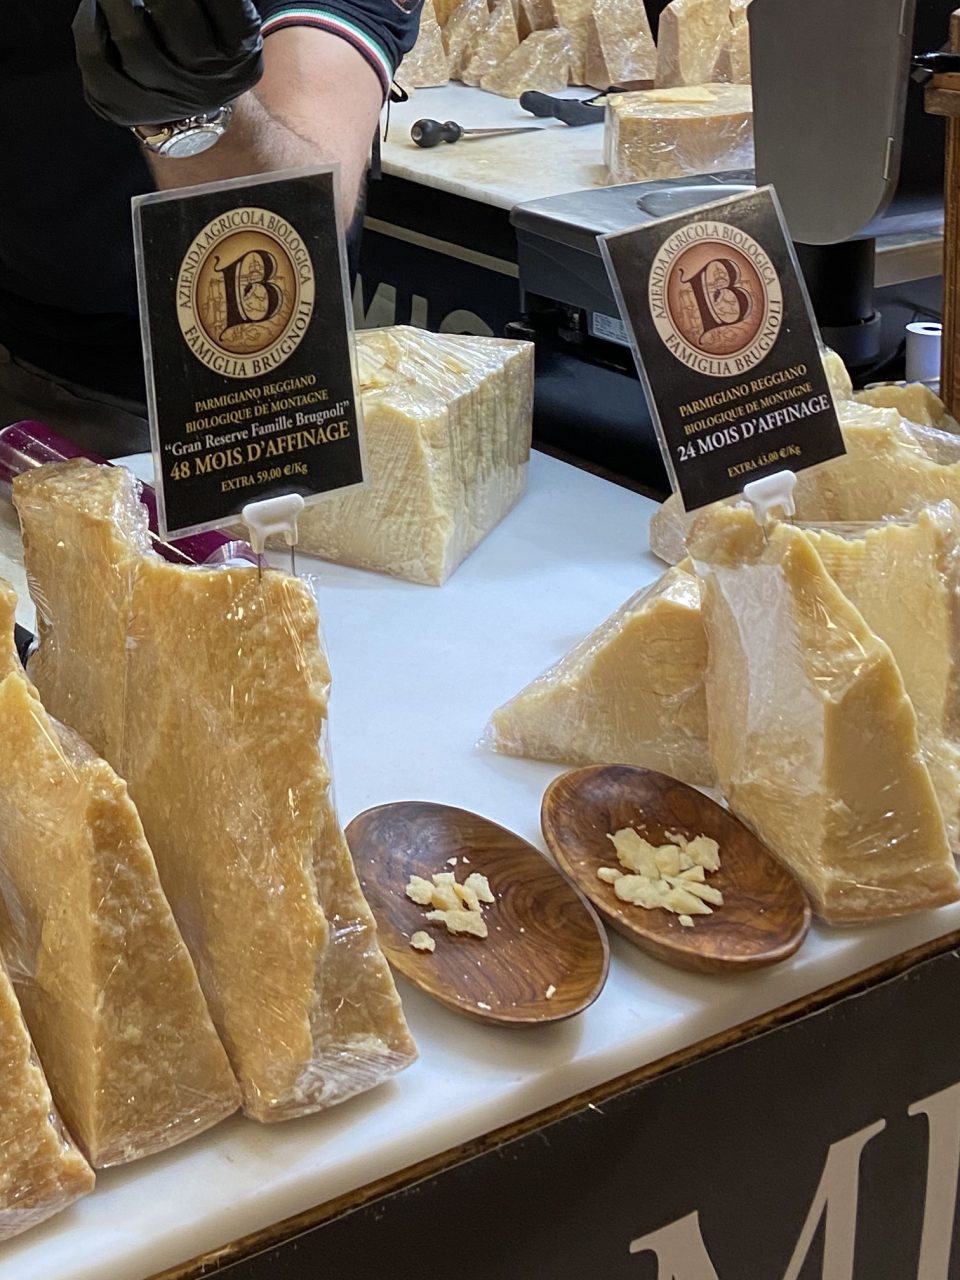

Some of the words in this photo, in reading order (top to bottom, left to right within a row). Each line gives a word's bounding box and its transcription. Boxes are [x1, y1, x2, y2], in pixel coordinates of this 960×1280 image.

[179, 242, 207, 309] AZIENDA
[205, 210, 265, 246] AGRICOLA
[266, 215, 312, 286] BIOLOGICA
[652, 255, 670, 320] AZIENDA
[666, 223, 720, 260] AGRICOLA
[722, 226, 776, 286] BIOLOGICA
[184, 325, 247, 376] FAMIGLIA
[253, 301, 312, 374] BRUGNOLI
[665, 334, 732, 376] FAMIGLIA
[736, 299, 782, 373] BRUGNOLI
[185, 408, 253, 433] BIOLOGIQUE
[254, 403, 269, 417] DE
[270, 389, 329, 413] MONTAGNE
[194, 387, 261, 413] PARMIGIANO
[263, 374, 316, 396] REGGIANO
[678, 384, 749, 417] PARMIGIANO
[750, 364, 807, 393] REGGIANO
[684, 406, 745, 436] BIOLOGIQUE
[745, 401, 760, 415] DE
[761, 382, 814, 409] MONTAGNE
[205, 430, 249, 449] Reserve
[251, 416, 293, 437] Famille
[677, 441, 697, 462] 24
[697, 425, 740, 455] MOIS
[169, 461, 191, 481] 48
[194, 447, 243, 475] MOIS
[221, 474, 255, 492] EXTRA
[728, 459, 757, 478] EXTRA
